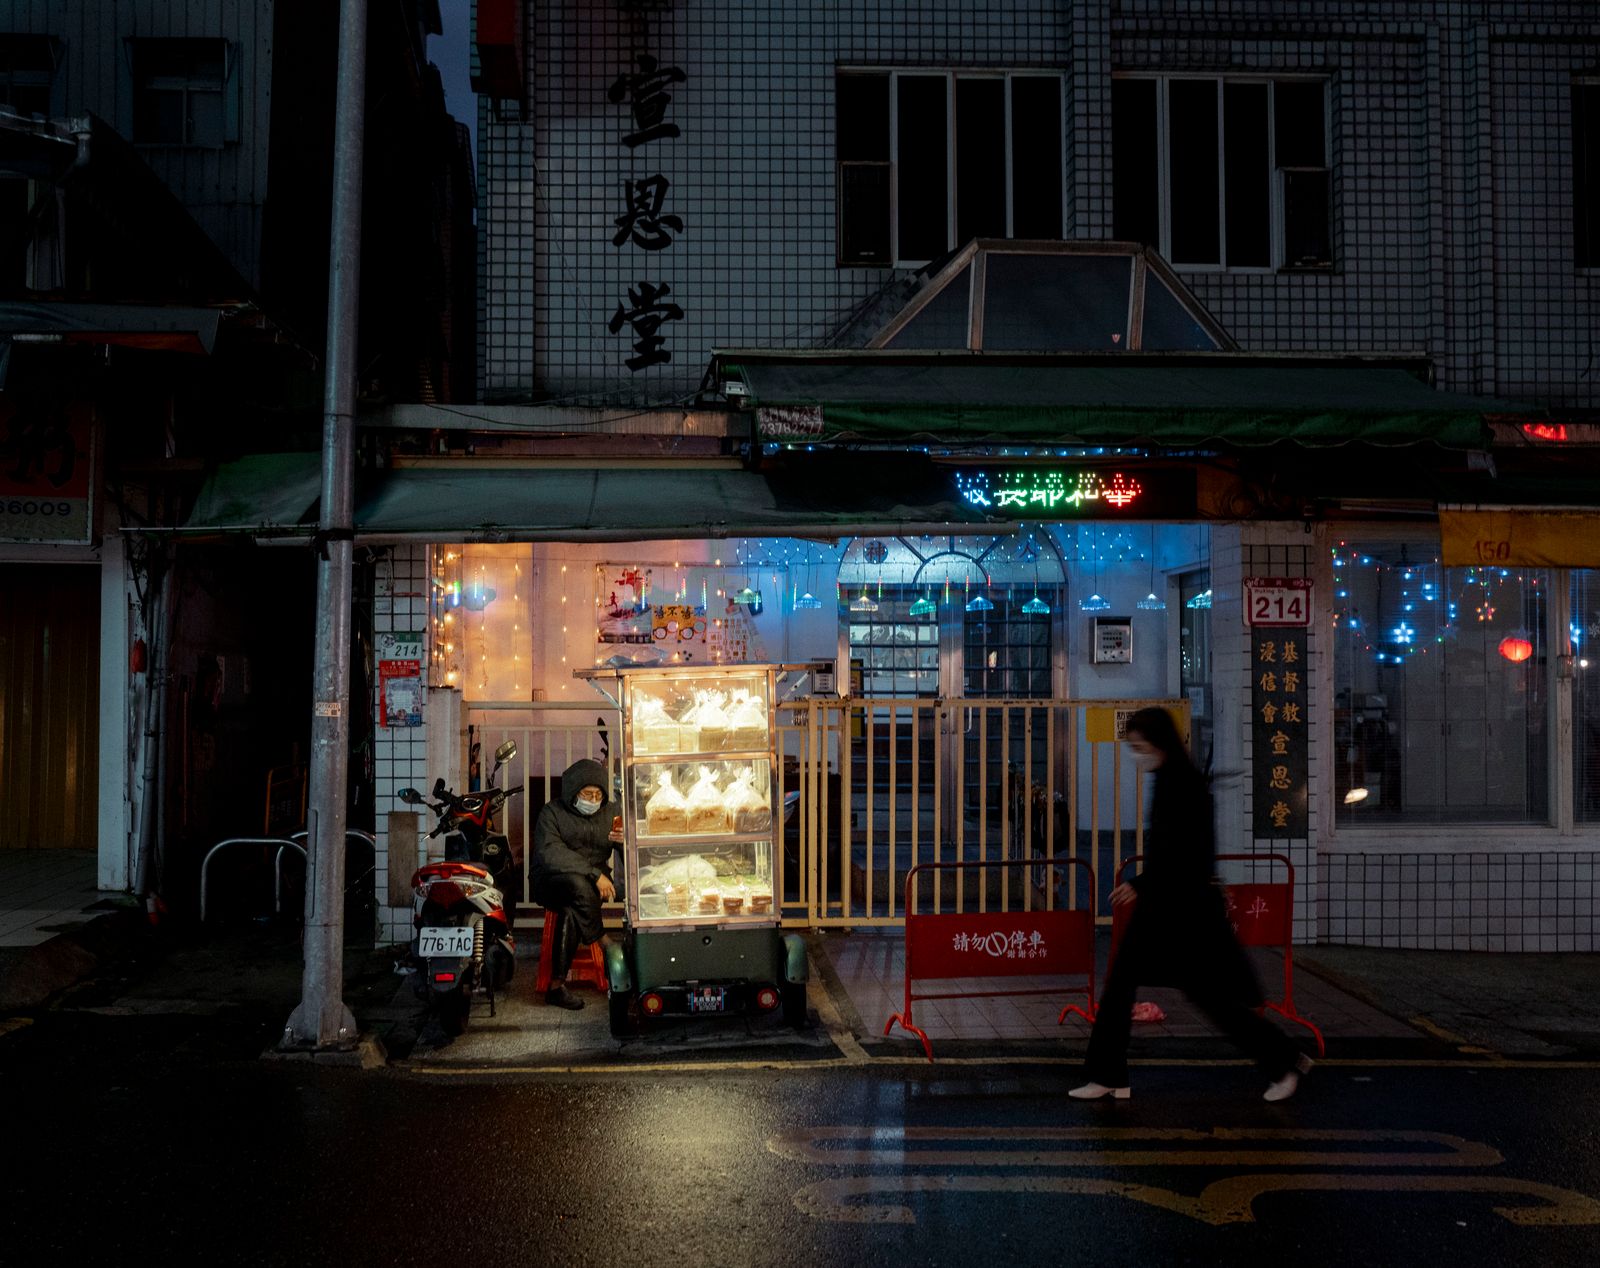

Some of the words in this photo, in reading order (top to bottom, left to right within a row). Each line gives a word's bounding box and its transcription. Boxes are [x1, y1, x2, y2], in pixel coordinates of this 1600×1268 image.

[608, 55, 686, 370] 宣恩堂
[1255, 596, 1302, 619] 214
[395, 645, 418, 656] 214
[1259, 640, 1279, 724] 浸信會
[1281, 640, 1301, 723] 基督教
[1269, 729, 1292, 828] 宣恩堂
